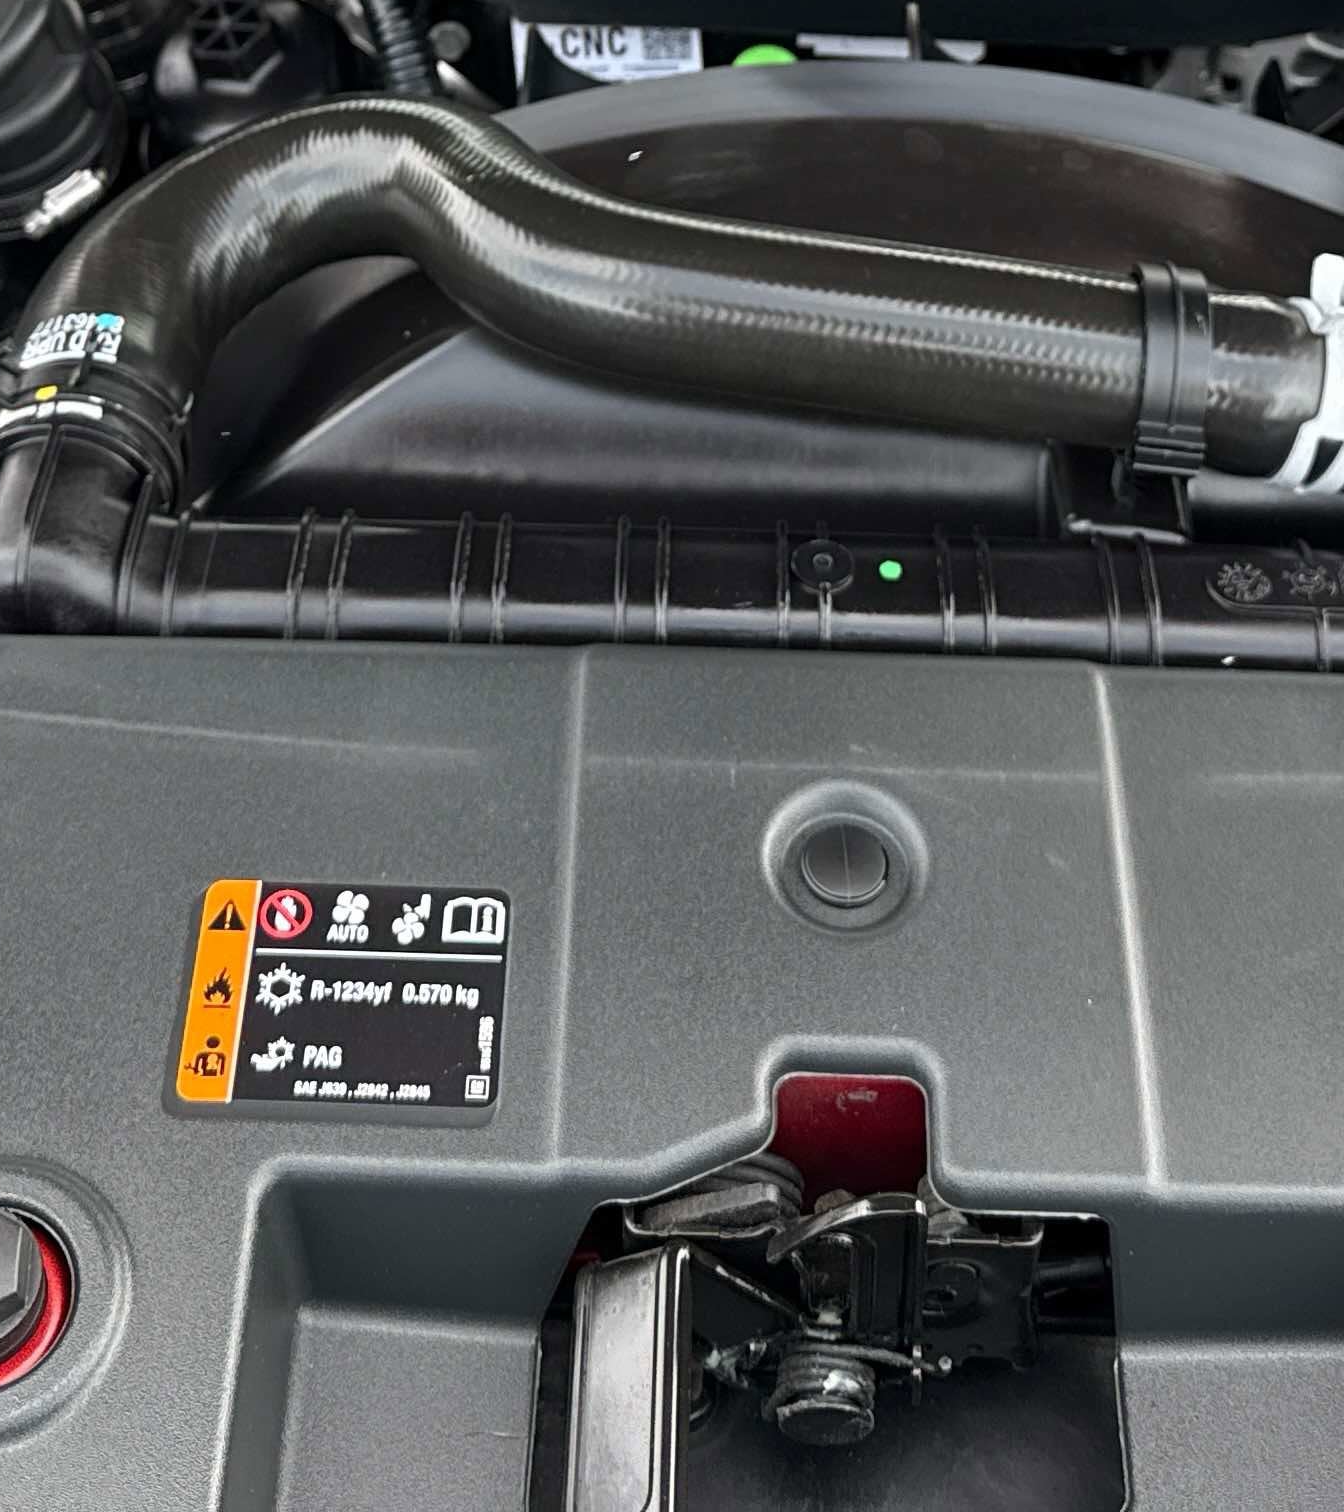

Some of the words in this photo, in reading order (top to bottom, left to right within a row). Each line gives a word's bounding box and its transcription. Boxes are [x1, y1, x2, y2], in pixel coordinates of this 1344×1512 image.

[560, 26, 628, 58] CNC
[326, 923, 370, 944] AUTO
[309, 980, 393, 1007] R-1234yf
[401, 982, 453, 1006] 0.570
[455, 983, 480, 1010] kg
[302, 1044, 344, 1070] PAG
